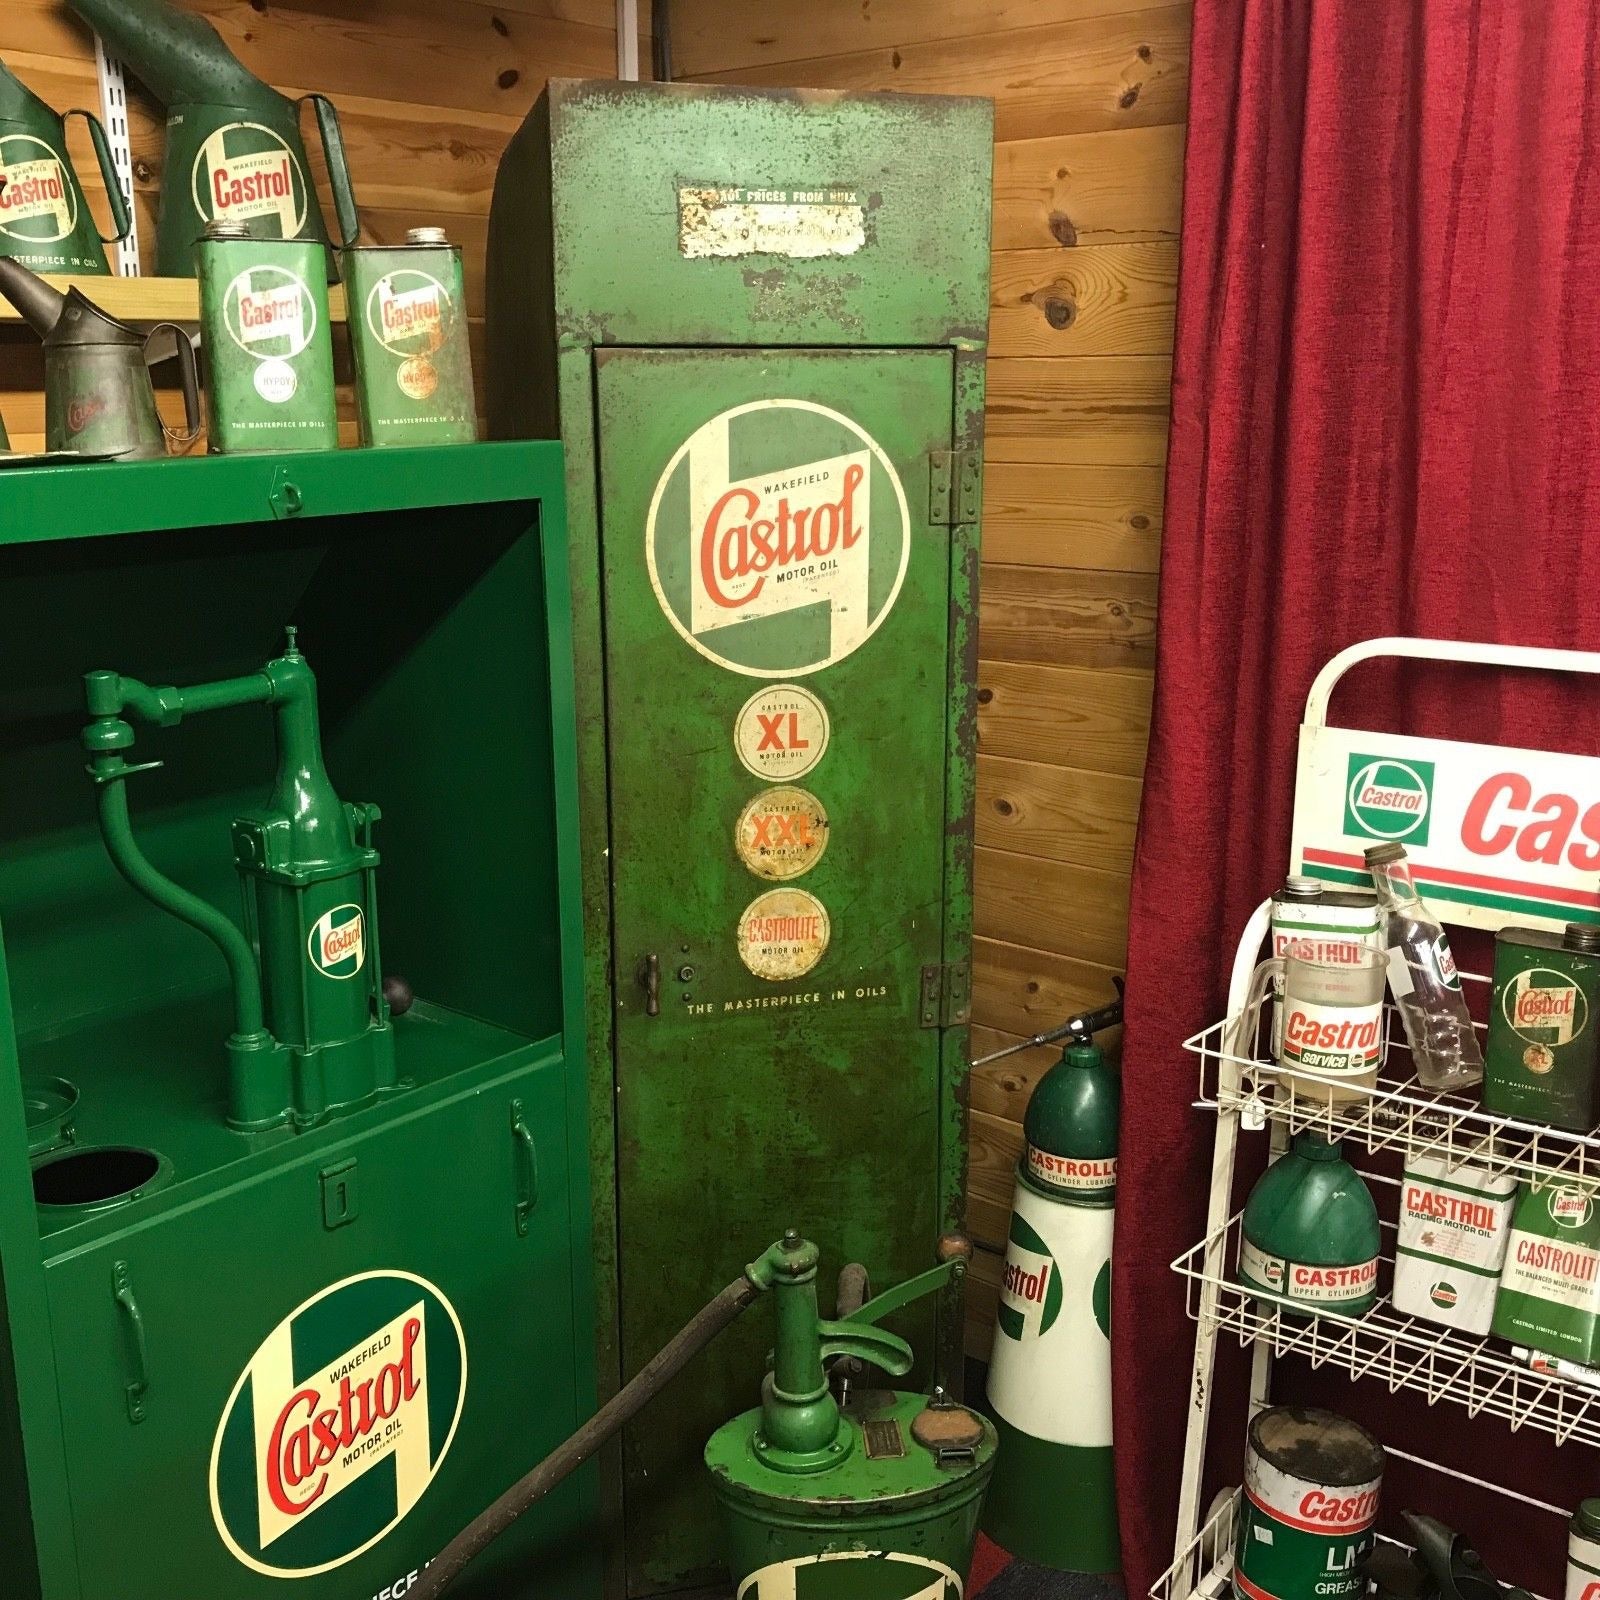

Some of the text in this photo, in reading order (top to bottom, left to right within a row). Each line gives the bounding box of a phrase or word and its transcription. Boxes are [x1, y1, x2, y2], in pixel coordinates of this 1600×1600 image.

[233, 159, 273, 171] WAKEFIELD
[213, 159, 290, 209] Castrol
[793, 191, 824, 203] FROM
[237, 203, 263, 213] MOTOR
[240, 295, 299, 327] Castrol
[383, 298, 440, 329] Castrol
[394, 416, 438, 424] MASTERPIECE
[764, 471, 830, 496] WAKEFIELD
[700, 463, 864, 609] Castrol
[776, 559, 839, 584] MOTOR OIL
[762, 703, 799, 711] CASTROL
[756, 712, 809, 751] XL
[760, 752, 786, 760] MOTOR
[1361, 788, 1423, 811] Castrol
[751, 814, 816, 848] XXL
[1460, 772, 1600, 872] Cas
[324, 918, 361, 962] Castrol
[750, 916, 819, 943] CASTROLITE
[762, 947, 788, 955] MOTOR
[687, 986, 887, 1015] THE MASTERPIECE IN OILS
[1518, 990, 1574, 1024] Castrol
[1287, 1011, 1380, 1050] Castrol
[1302, 1051, 1347, 1068] service
[1047, 1173, 1080, 1185] CYLINDER
[1407, 1187, 1497, 1232] CASTROL
[1408, 1210, 1492, 1239] RACING MOTOR OIL
[1515, 1268, 1525, 1277] THE
[1525, 1273, 1553, 1284] BALANCED
[1294, 1287, 1320, 1297] UPPER
[1327, 1287, 1362, 1297] CYLINDER
[1512, 1318, 1583, 1344] CASTROL LIMITED LONDON
[329, 1334, 391, 1385] WAKEFIELD
[266, 1317, 421, 1516] Castrol
[342, 1418, 402, 1468] MOTOR OIL
[1315, 1578, 1363, 1595] GREAS
